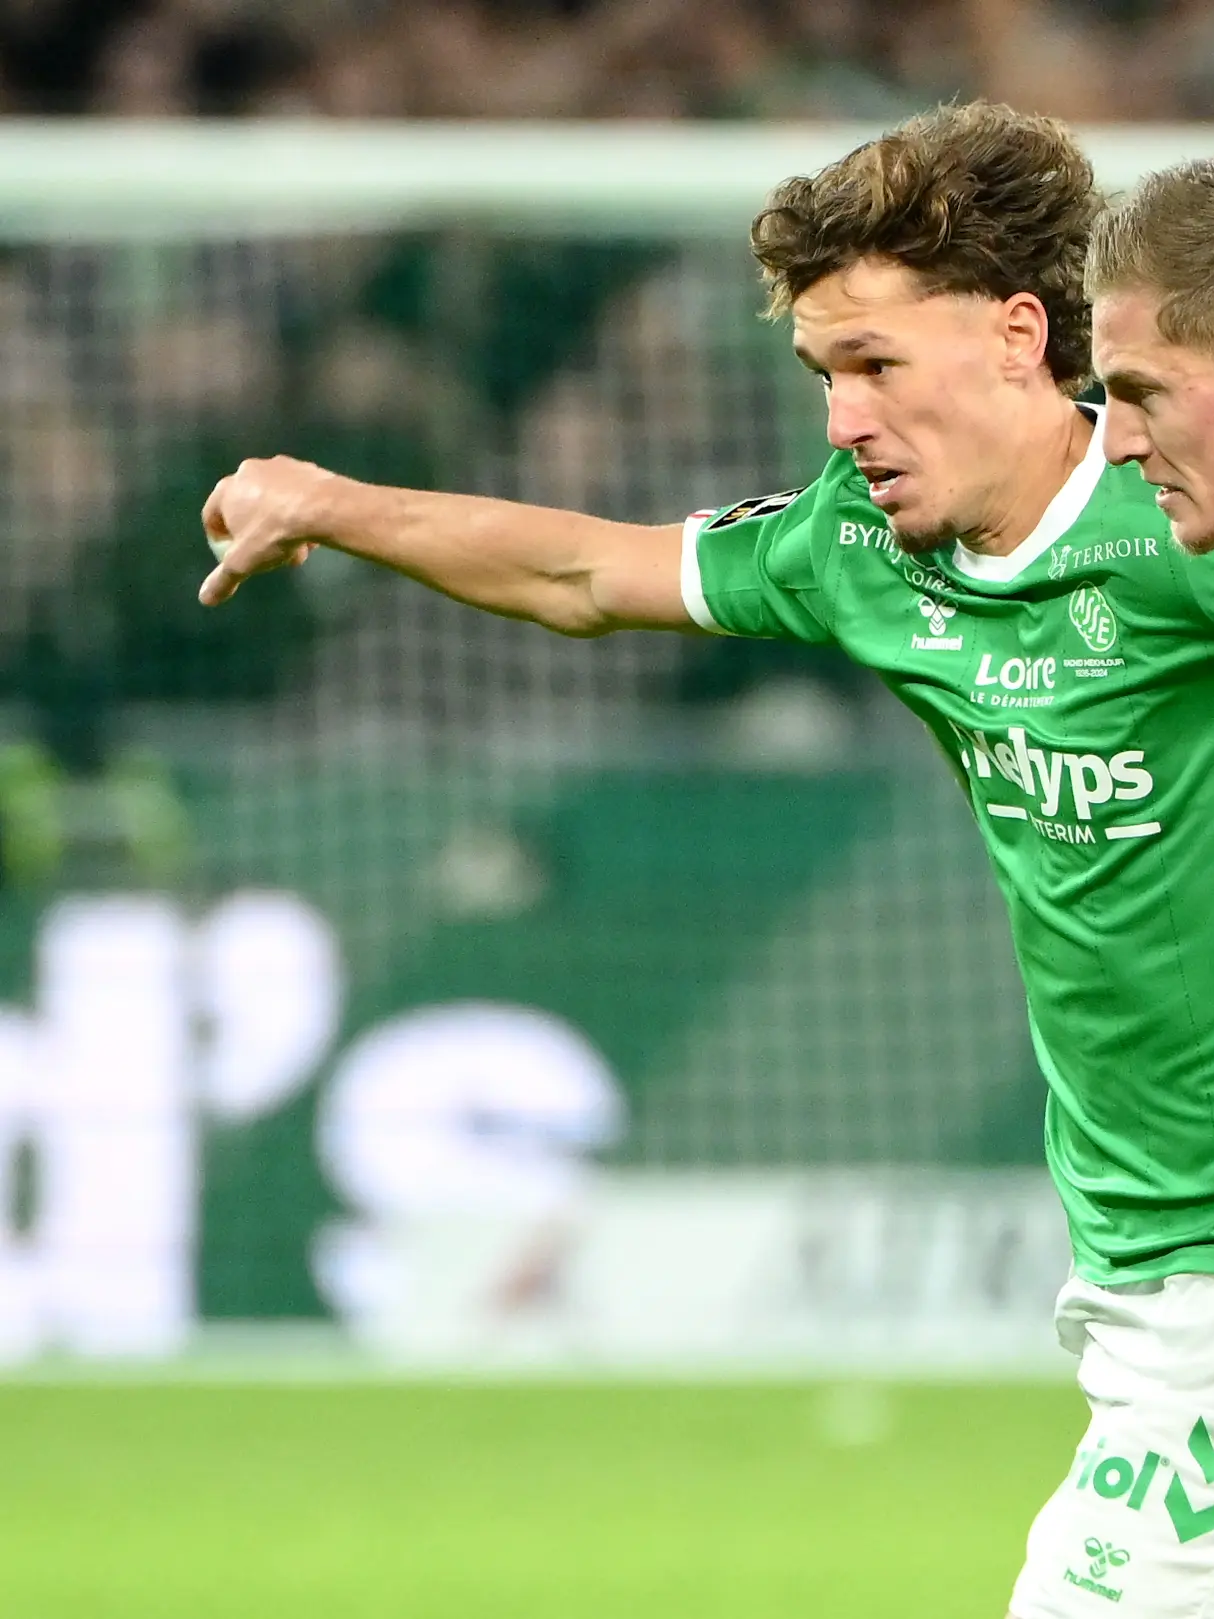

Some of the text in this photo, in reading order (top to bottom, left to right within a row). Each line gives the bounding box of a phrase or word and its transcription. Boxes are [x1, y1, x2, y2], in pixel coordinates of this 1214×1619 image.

[1072, 537, 1160, 569] TERROIR
[1073, 588, 1111, 645] ASSE
[911, 633, 963, 651] hummel
[974, 653, 1056, 690] Loire
[970, 690, 985, 704] LE
[1063, 1567, 1124, 1603] hummel
